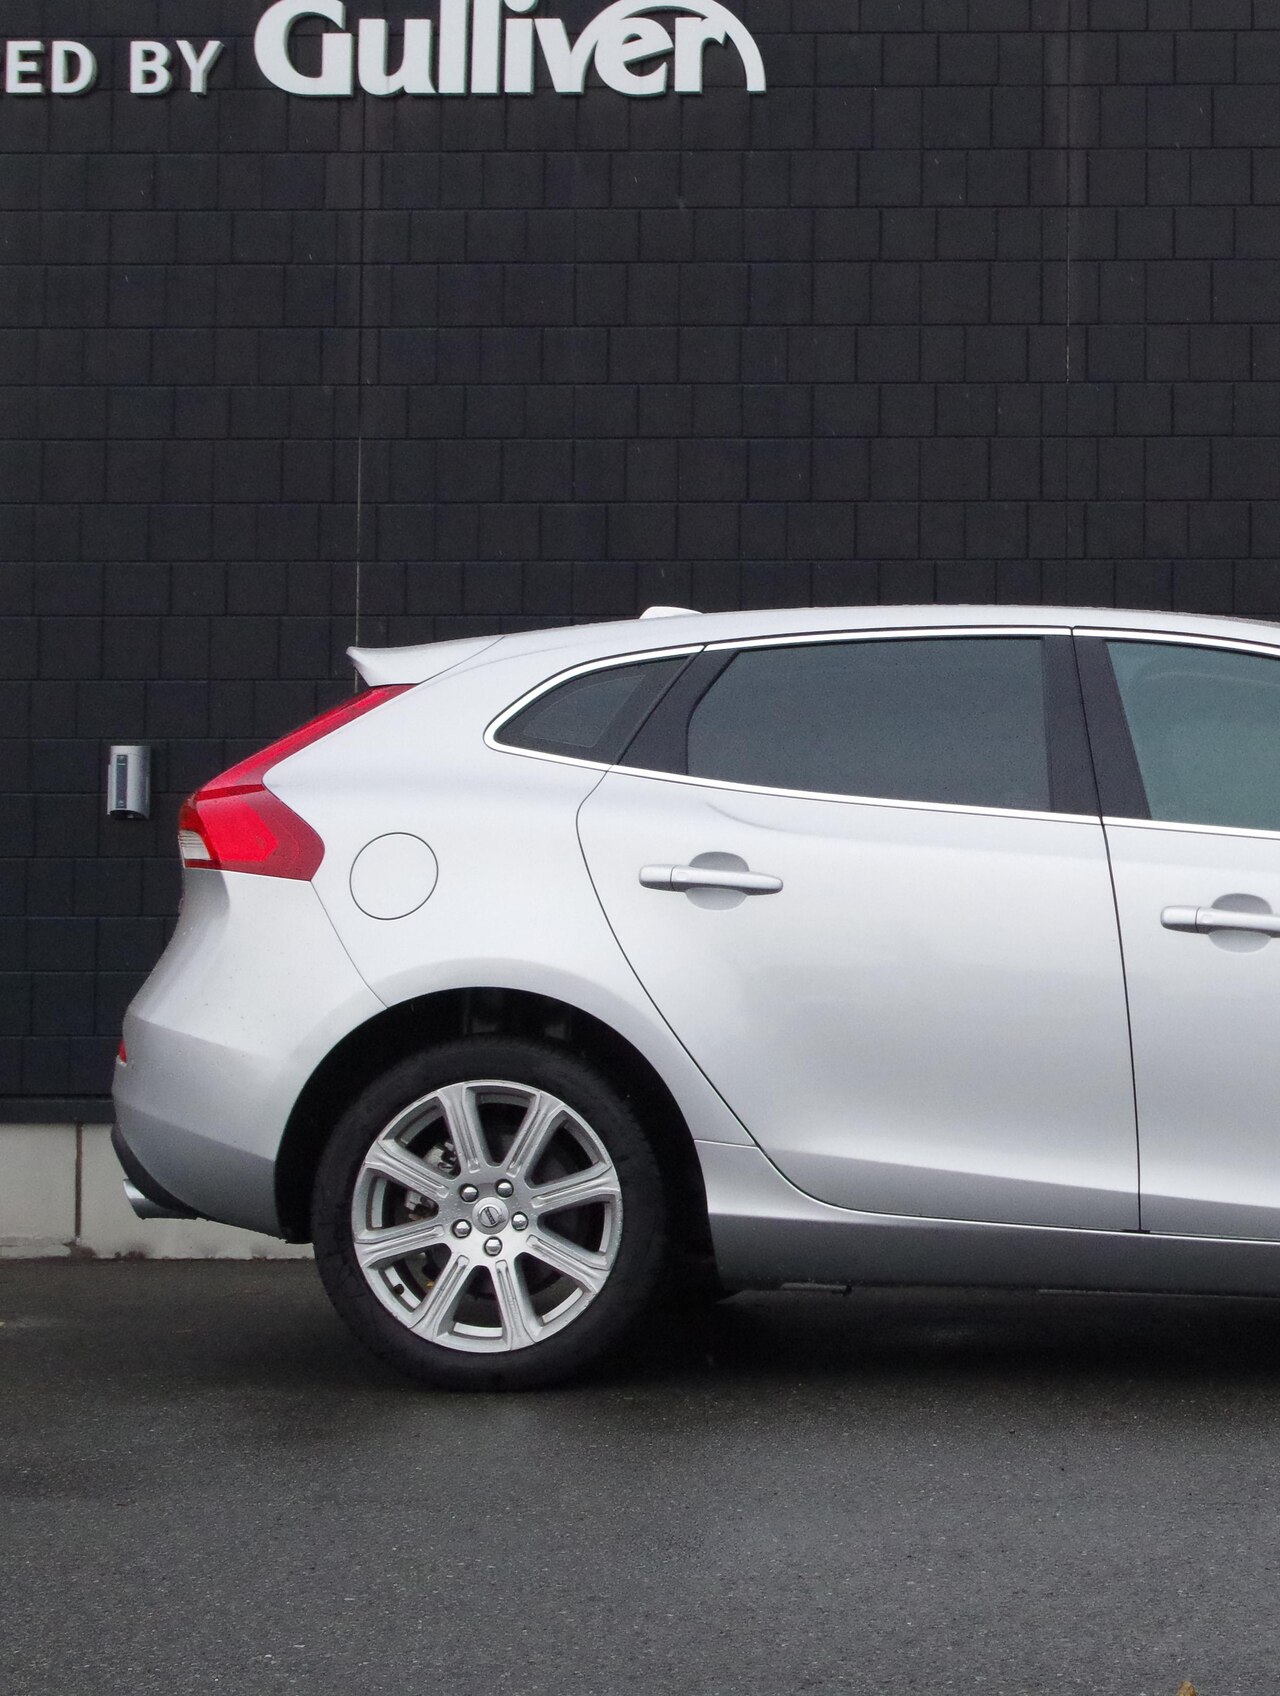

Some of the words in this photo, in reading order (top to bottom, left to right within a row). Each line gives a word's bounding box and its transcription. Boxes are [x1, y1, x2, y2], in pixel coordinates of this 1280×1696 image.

[5, 40, 97, 95] ED
[130, 40, 225, 95] BY
[254, 0, 766, 97] Gulliver
